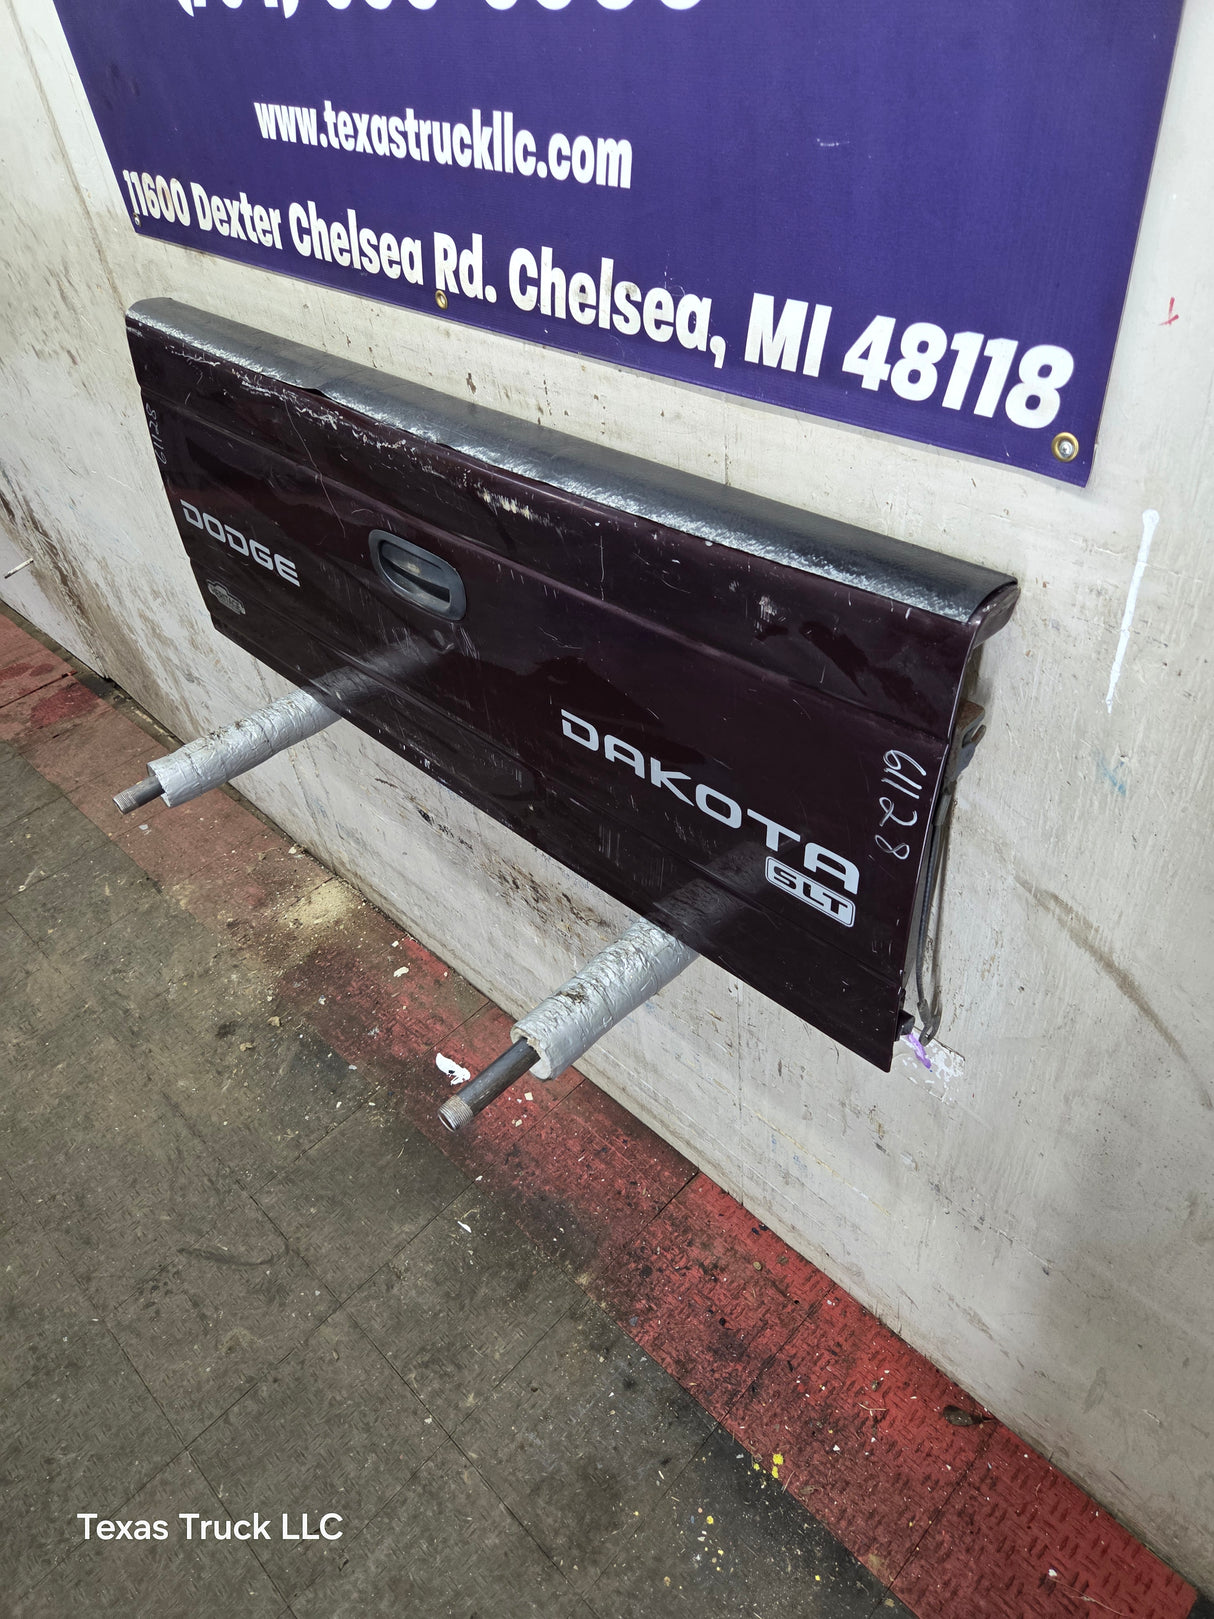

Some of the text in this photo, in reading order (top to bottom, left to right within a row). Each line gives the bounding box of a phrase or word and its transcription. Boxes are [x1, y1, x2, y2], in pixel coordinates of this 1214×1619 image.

[254, 100, 633, 189] www.texastruckllc.com
[122, 169, 1075, 429] 11600 Dexter Chelsea Rd. Chelsea, MI 48118
[180, 499, 301, 587] DODGE
[560, 708, 860, 895] DAKOTA
[875, 749, 927, 860] 61128
[768, 859, 853, 924] SLT
